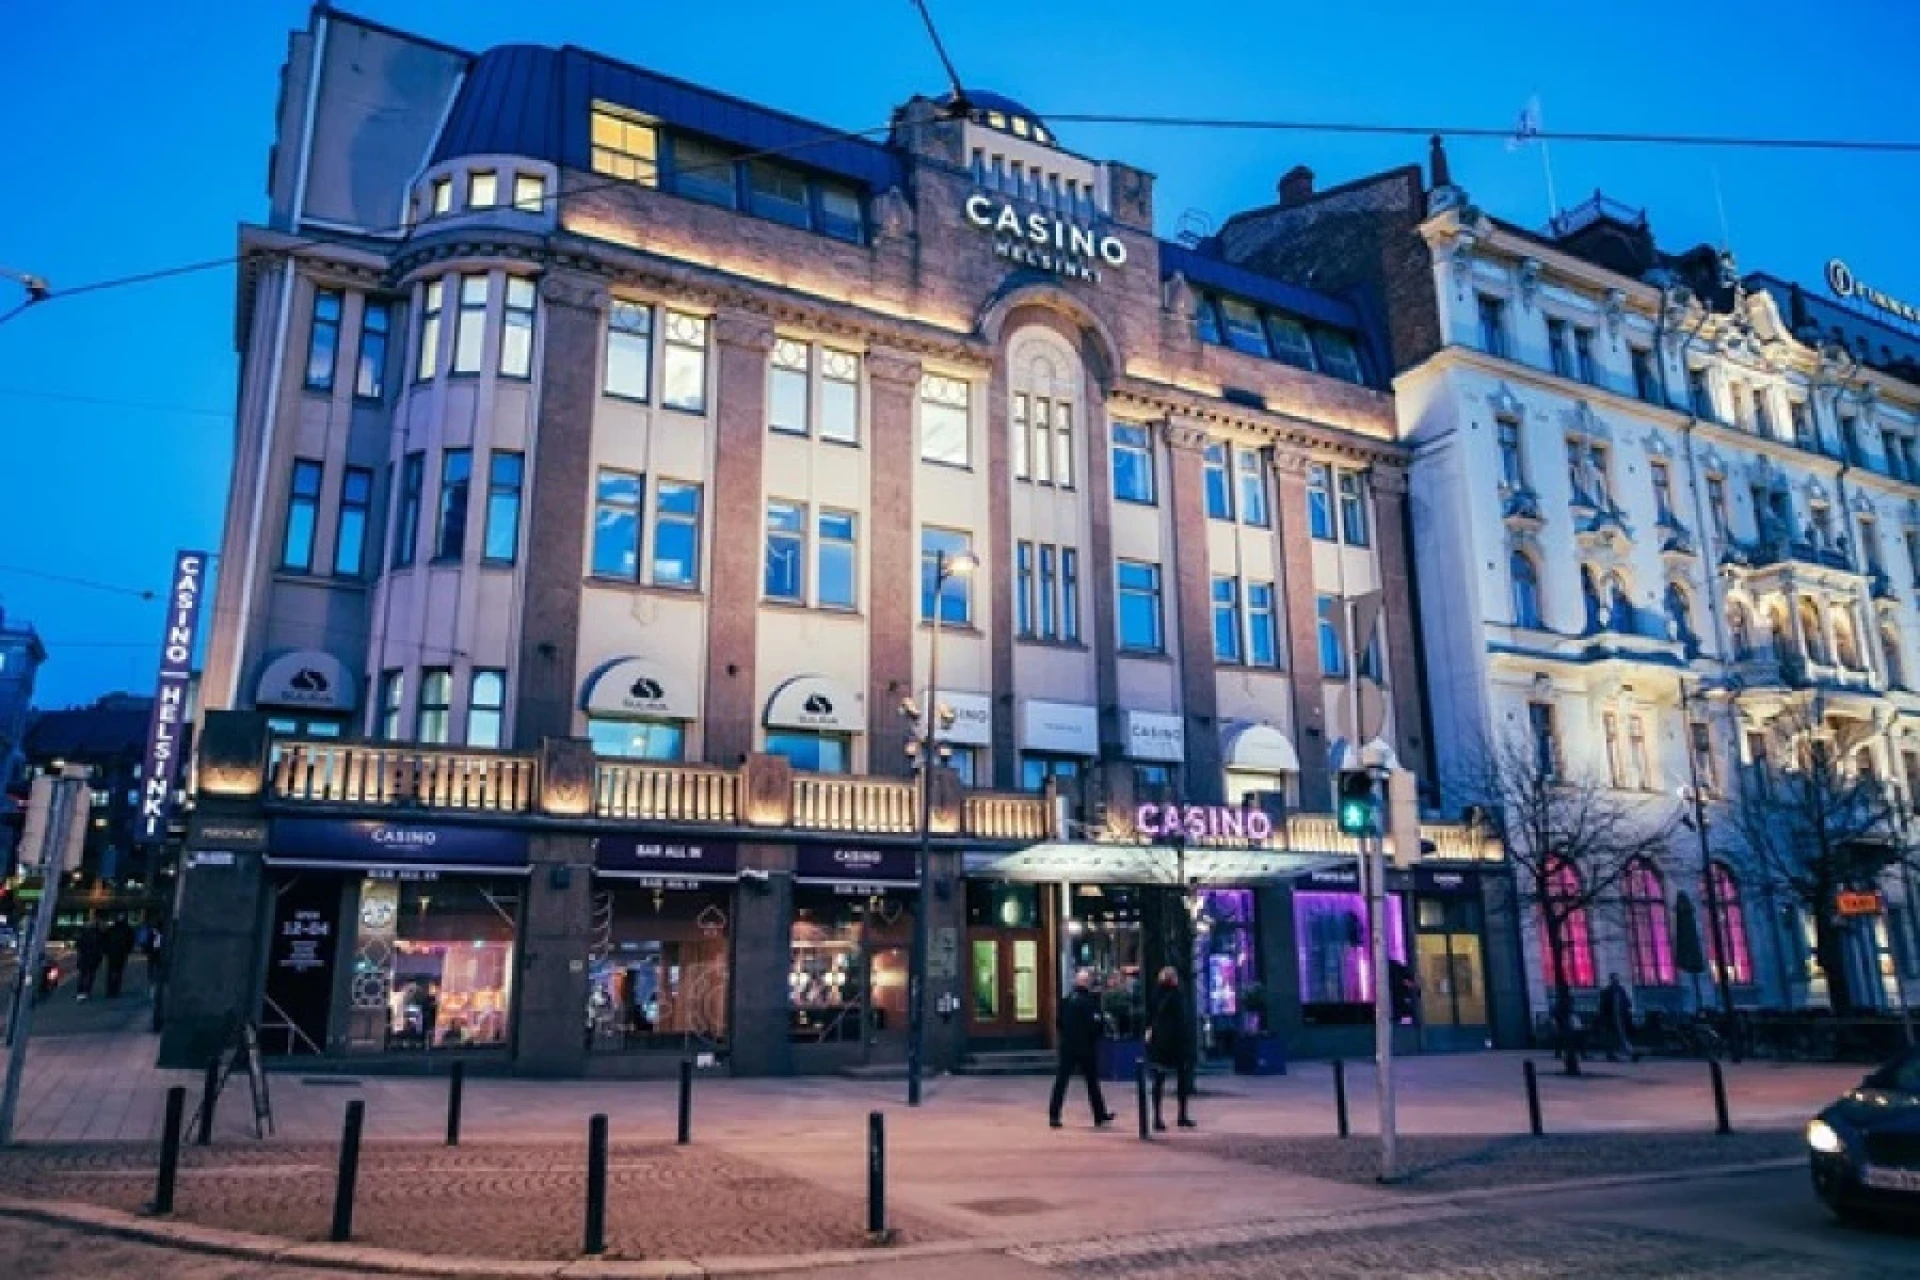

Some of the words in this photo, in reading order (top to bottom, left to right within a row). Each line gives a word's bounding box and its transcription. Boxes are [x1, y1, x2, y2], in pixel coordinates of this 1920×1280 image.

[966, 194, 1127, 267] CASINO
[996, 241, 1101, 283] HELSINKI
[166, 556, 199, 663] CASINO
[1132, 722, 1181, 739] CASINO
[144, 684, 180, 835] HELSINKI
[371, 829, 436, 845] CASINO
[1138, 801, 1271, 839] CASINO
[636, 844, 662, 858] BAR
[665, 845, 686, 859] ALL
[834, 849, 881, 864] CASINO
